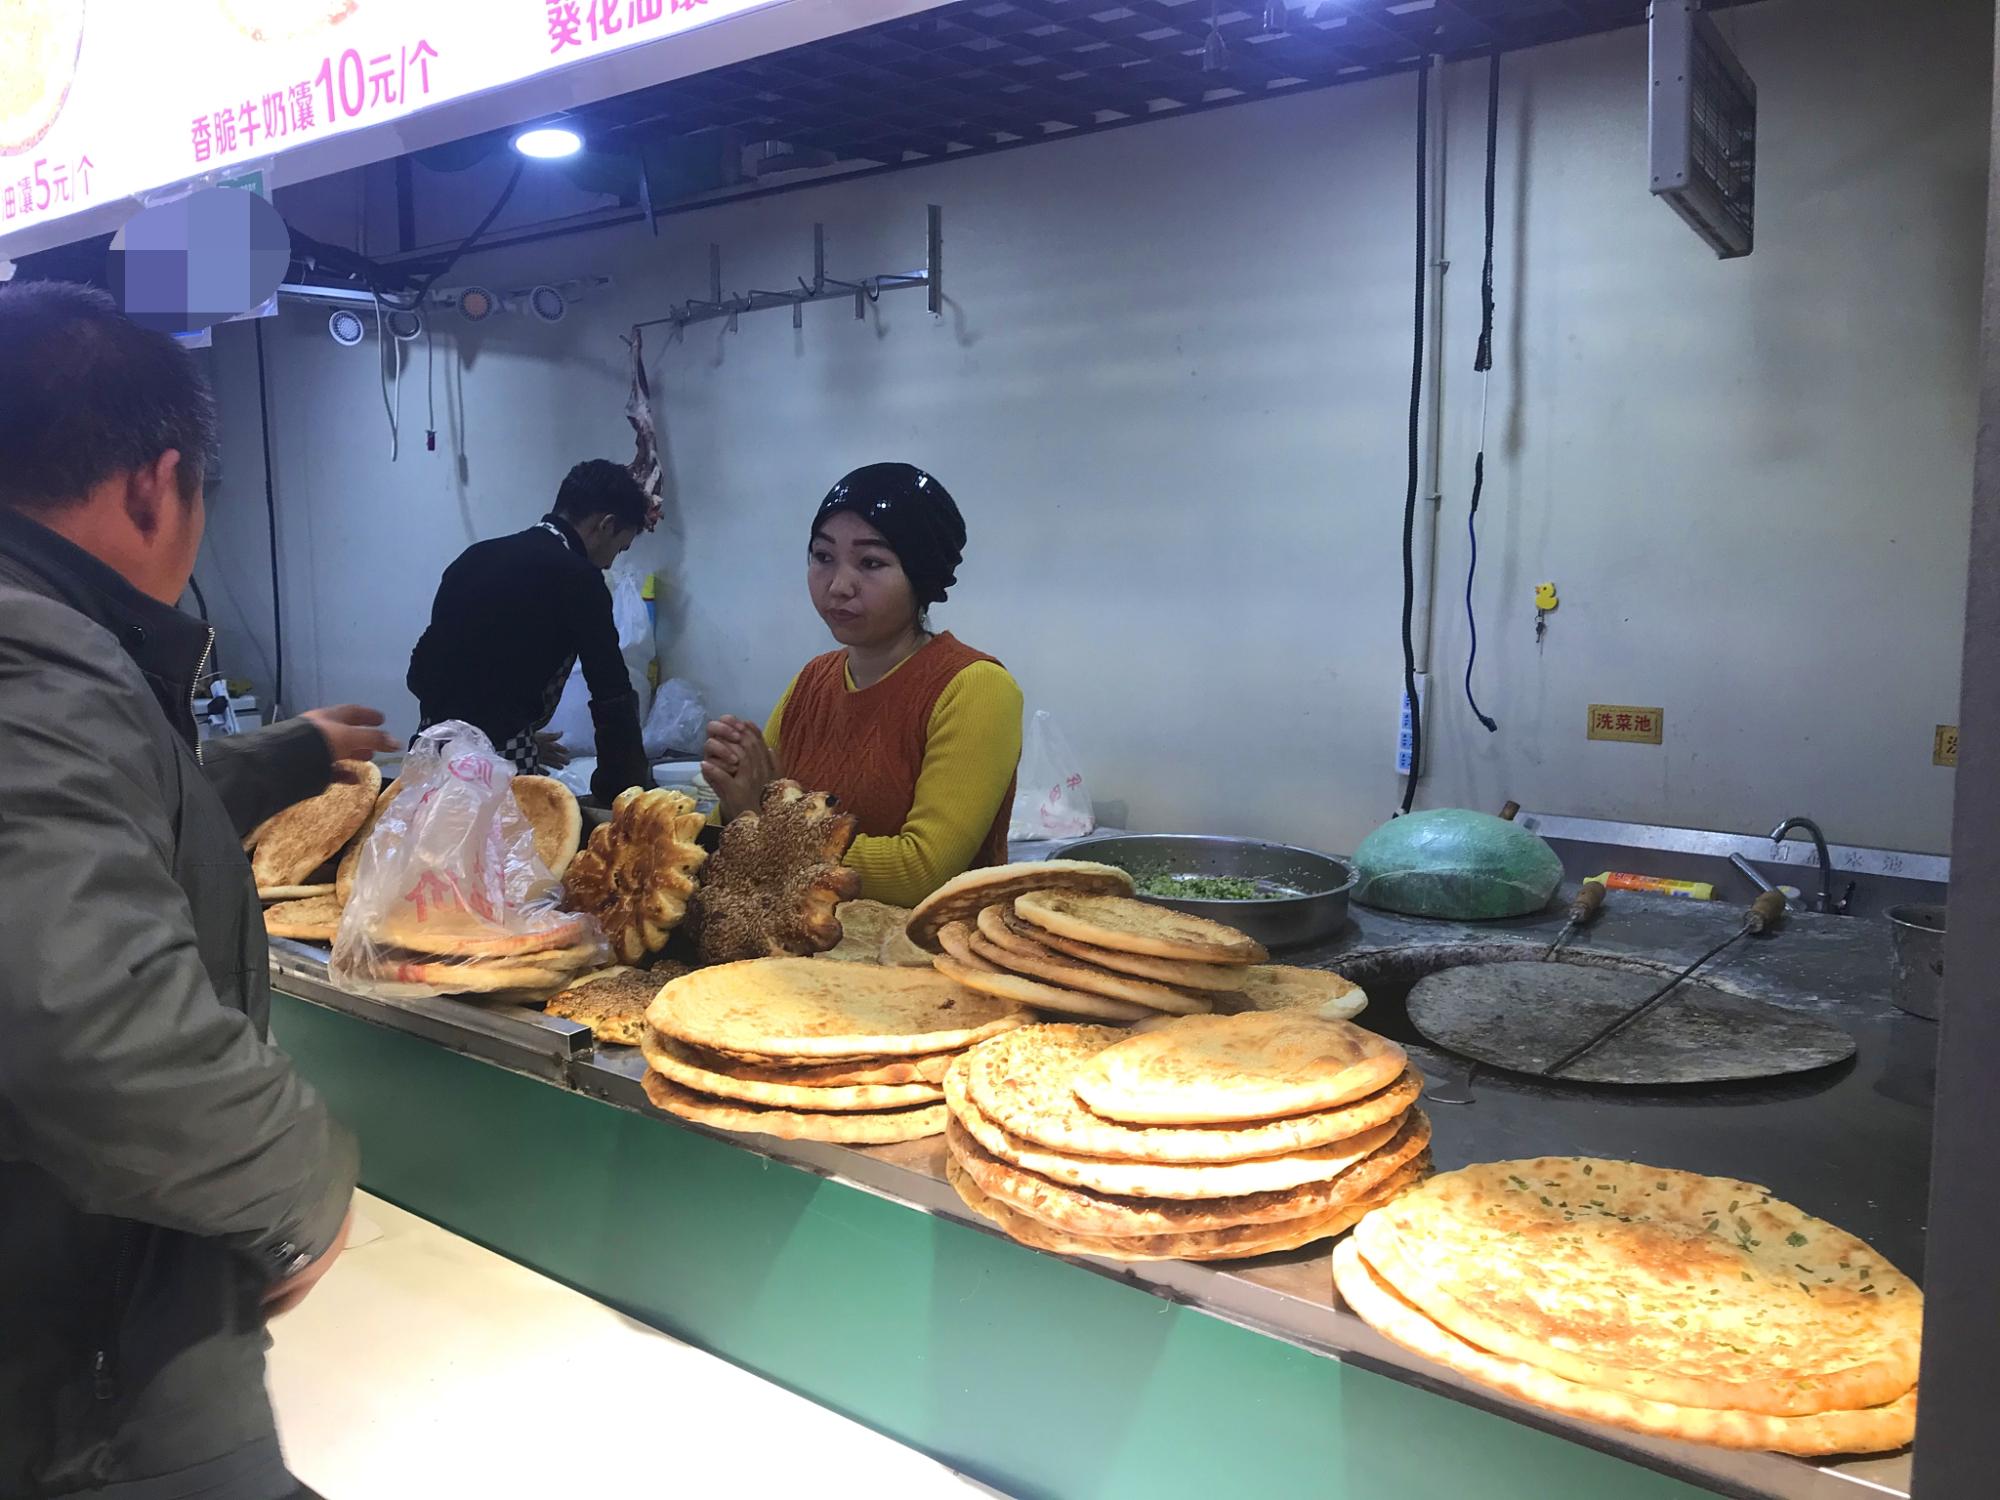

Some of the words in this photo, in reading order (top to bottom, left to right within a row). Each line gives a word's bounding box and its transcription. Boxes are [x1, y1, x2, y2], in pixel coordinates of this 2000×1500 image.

[191, 39, 439, 162] 香脆牛奶馕10元/个
[1595, 712, 1652, 732] 洗菜池
